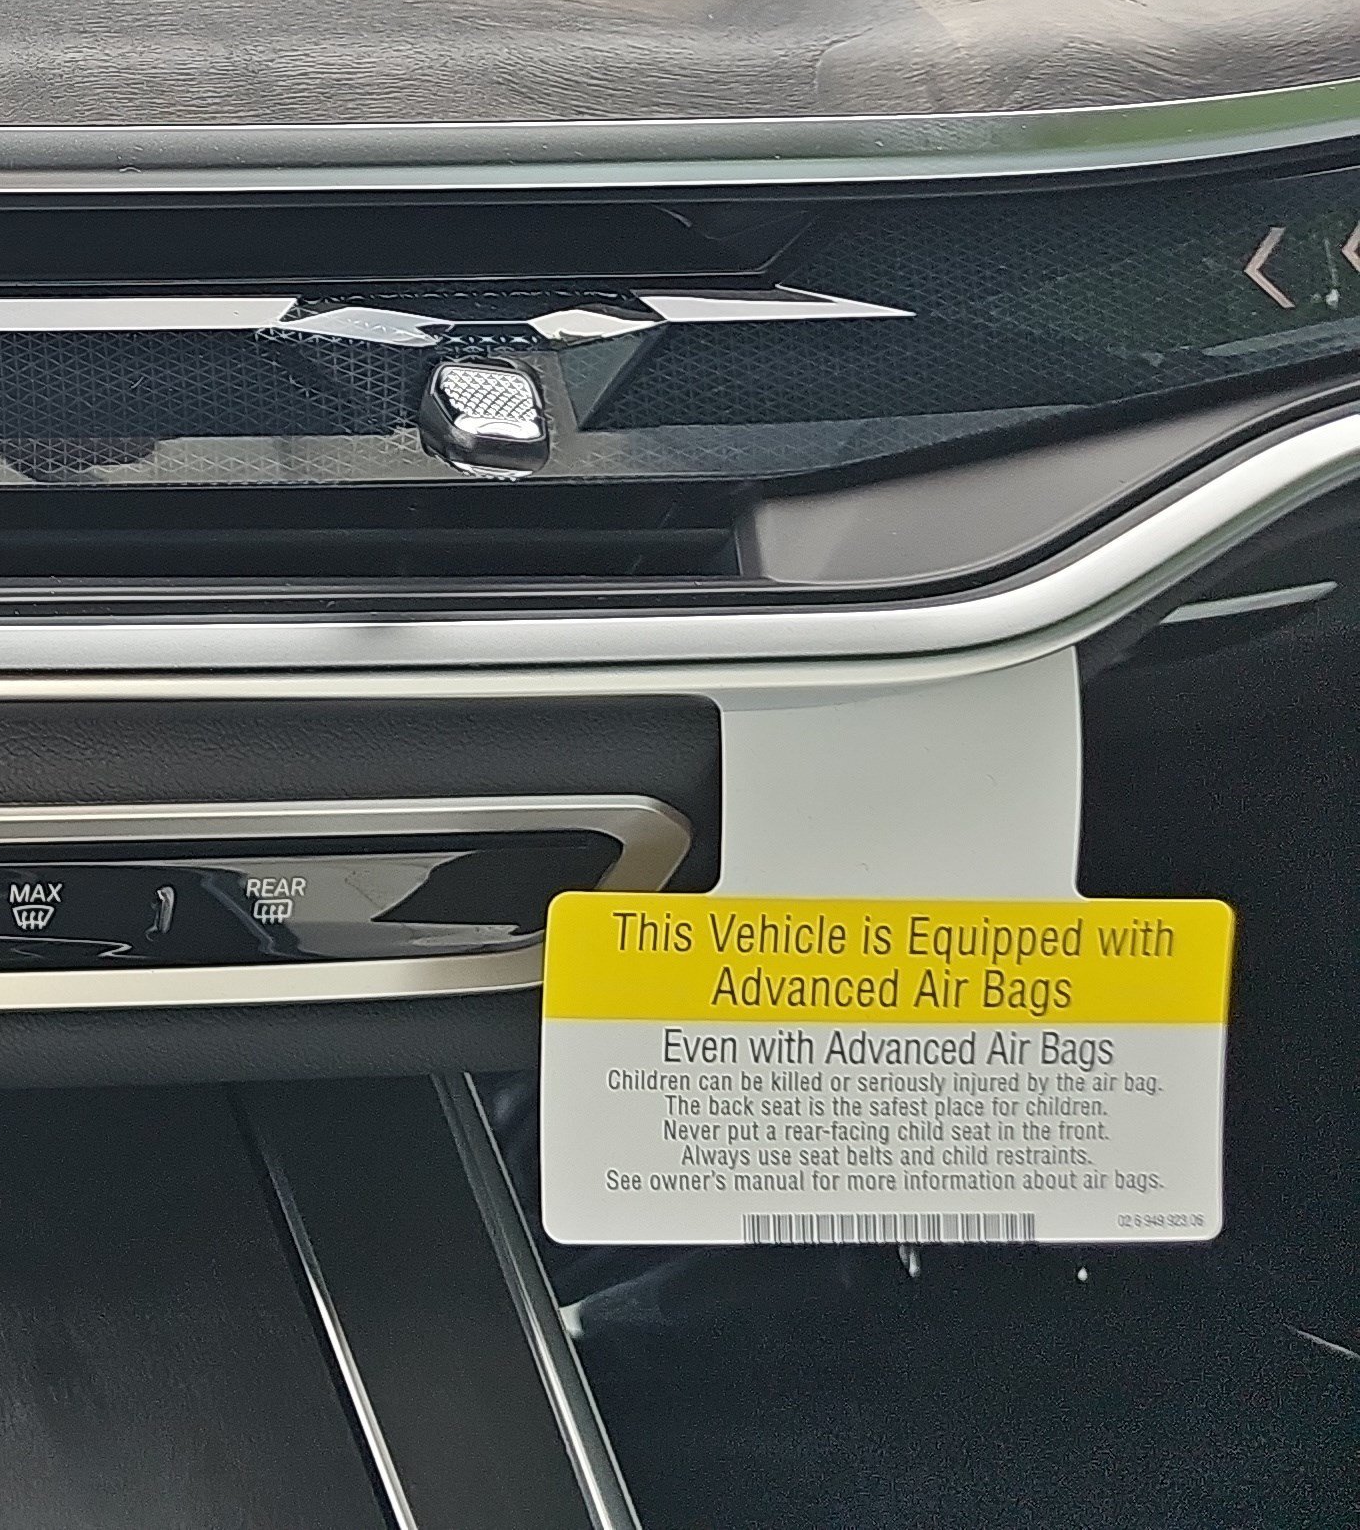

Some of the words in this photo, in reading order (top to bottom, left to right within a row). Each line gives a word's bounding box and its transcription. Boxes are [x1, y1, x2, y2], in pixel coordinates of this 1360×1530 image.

[8, 883, 63, 904] MAX
[245, 877, 307, 899] REAR
[612, 911, 693, 953] This
[709, 913, 847, 955] Vehicle
[863, 915, 892, 955] is
[908, 916, 1083, 965] Equipped
[1097, 918, 1175, 957] with
[711, 966, 899, 1008] Advanced
[912, 968, 969, 1008] Air
[982, 968, 1073, 1017] Bags
[663, 1028, 737, 1064] Even
[749, 1029, 814, 1064] with
[824, 1030, 976, 1065] Advanced
[986, 1031, 1031, 1065] Air
[1040, 1031, 1114, 1072] Bags
[607, 1069, 691, 1092] Children
[698, 1074, 732, 1092] can
[741, 1071, 763, 1092] be
[771, 1071, 823, 1092] killed
[830, 1075, 851, 1092] or
[857, 1072, 945, 1095] seriously
[953, 1072, 1019, 1096] injured
[1027, 1073, 1049, 1096] by
[1056, 1073, 1086, 1092] the
[1092, 1073, 1118, 1092] air
[1124, 1073, 1164, 1096] bag.
[665, 1094, 701, 1116] The
[708, 1095, 754, 1116] back
[761, 1097, 802, 1116] seat
[808, 1096, 825, 1116] is
[832, 1096, 862, 1116] the
[869, 1096, 928, 1117] safest
[935, 1097, 984, 1120] place
[991, 1096, 1019, 1116] for
[1026, 1097, 1108, 1117] children.
[663, 1119, 721, 1141] Never
[728, 1121, 760, 1144] put
[766, 1125, 777, 1141] a
[784, 1120, 889, 1145] rear-facing
[897, 1121, 944, 1142] child
[950, 1122, 991, 1141] seat
[998, 1121, 1015, 1141] in
[1022, 1121, 1051, 1141] the
[1058, 1121, 1110, 1142] front.
[681, 1144, 751, 1170] Always
[758, 1148, 792, 1166] use
[798, 1146, 840, 1166] seat
[847, 1145, 893, 1166] belts
[900, 1146, 935, 1166] and
[942, 1145, 988, 1166] child
[996, 1146, 1093, 1166] restraints.
[606, 1169, 642, 1191] See
[649, 1170, 727, 1191] owner's
[733, 1170, 805, 1191] manual
[811, 1170, 840, 1191] for
[847, 1173, 896, 1191] more
[904, 1170, 1016, 1191] information
[1022, 1170, 1078, 1190] about
[1083, 1170, 1108, 1190] air
[1114, 1170, 1165, 1194] bags.
